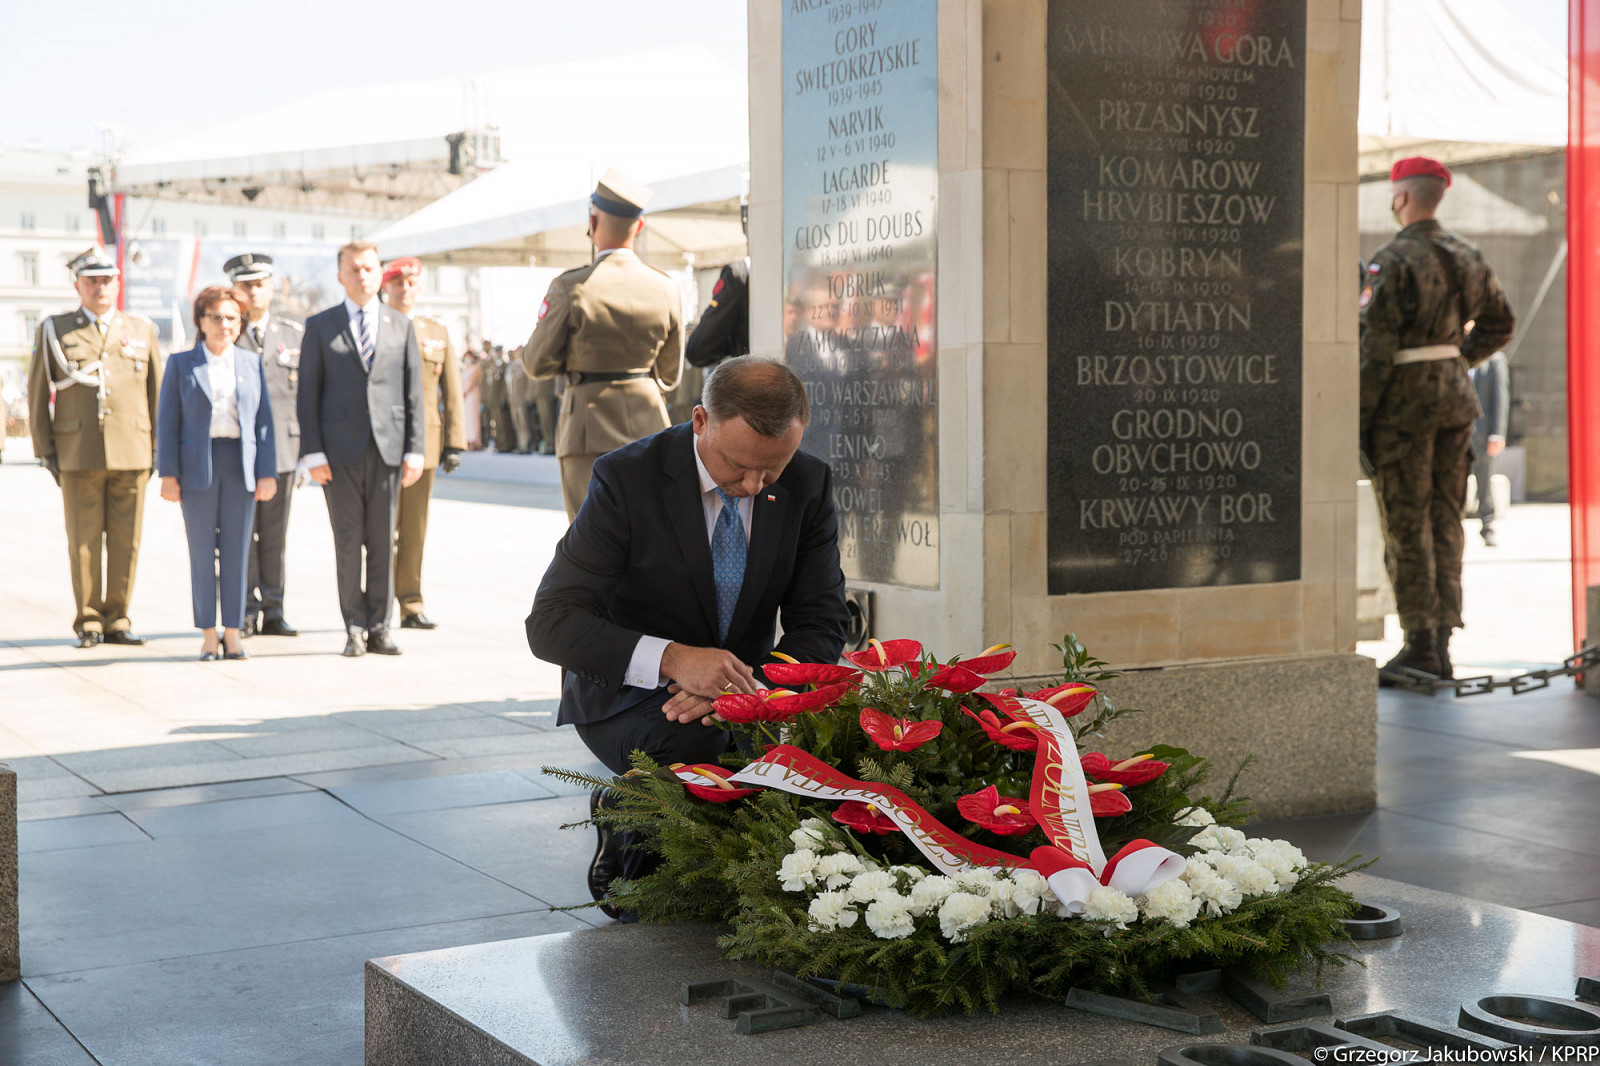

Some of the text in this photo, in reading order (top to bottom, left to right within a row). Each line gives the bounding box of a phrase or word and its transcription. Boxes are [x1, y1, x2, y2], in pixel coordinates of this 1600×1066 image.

[827, 80, 883, 107] 1939-1945
[1199, 84, 1238, 102] 1920
[828, 105, 884, 140] NARVIK
[1100, 98, 1261, 138] PRZASNYSZ
[817, 145, 827, 162] 12
[869, 132, 896, 153] 1940
[1195, 138, 1236, 156] 1920
[823, 159, 891, 195] LAGARDE
[865, 188, 893, 209] 1940
[795, 210, 923, 251] CLOS DU DOUBS
[1202, 227, 1241, 244] 1920
[867, 244, 893, 262] 1940
[826, 271, 887, 300] TOBRUK
[1193, 281, 1232, 297] 1920
[1104, 300, 1251, 332] DYTIATYN
[1138, 334, 1158, 350] 16
[1180, 333, 1221, 350] 1920
[1076, 354, 1280, 386] BRZOSTOWICE
[831, 379, 936, 406] WARSZAWSKIE
[1182, 388, 1221, 404] 1920
[1111, 408, 1243, 440] GRODNO
[829, 433, 886, 460] LENINO
[1091, 441, 1262, 475] OBVCHOWO
[1198, 474, 1237, 491] 1920
[1079, 494, 1212, 530] KRWAWY
[896, 519, 937, 548] WOŁ.
